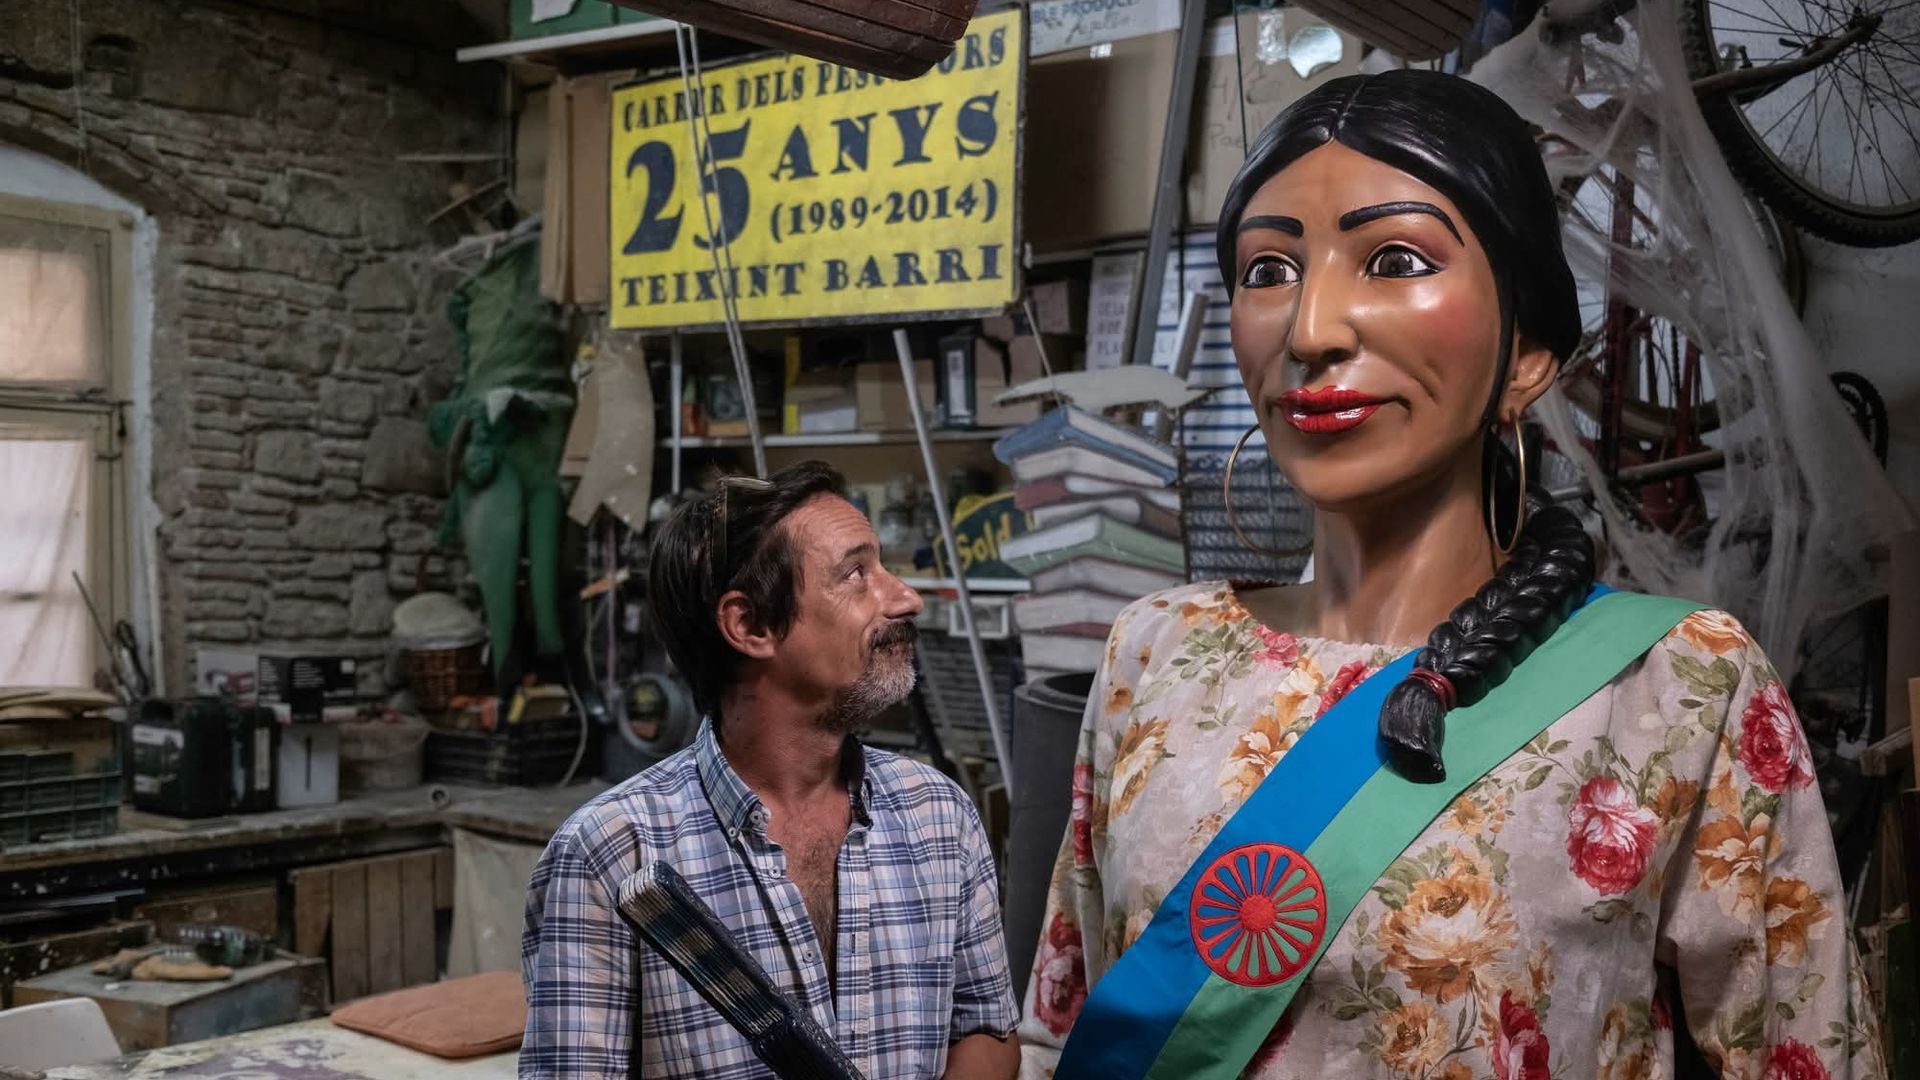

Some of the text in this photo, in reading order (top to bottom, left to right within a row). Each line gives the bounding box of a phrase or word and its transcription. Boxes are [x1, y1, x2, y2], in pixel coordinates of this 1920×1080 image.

[623, 84, 725, 132] CARRER
[737, 66, 804, 111] DELS
[816, 26, 1007, 96] PESORS
[770, 90, 1000, 183] ANYS
[621, 118, 752, 256] 25
[770, 178, 999, 243] (1989-2014)
[620, 243, 1004, 308] TEIXINT BARRI
